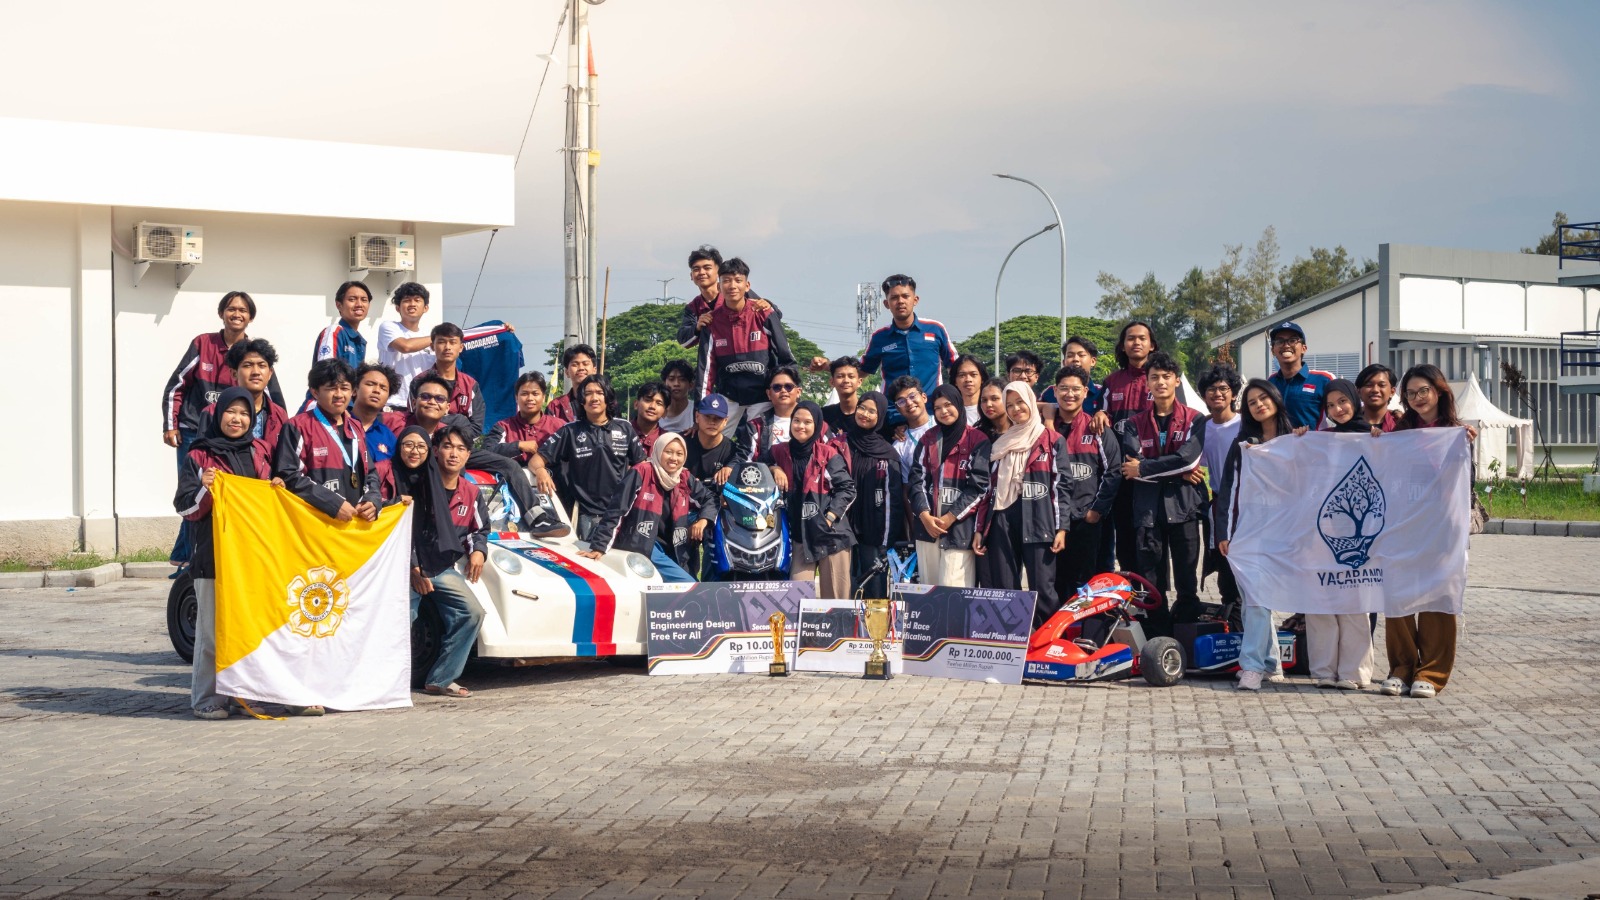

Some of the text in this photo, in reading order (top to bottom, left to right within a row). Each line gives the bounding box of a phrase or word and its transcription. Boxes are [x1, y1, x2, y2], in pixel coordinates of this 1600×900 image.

[1317, 568, 1384, 586] YACARAND
[650, 610, 672, 620] Drag
[650, 620, 736, 631] Engineering Design
[913, 622, 930, 630] Race
[689, 631, 701, 639] All
[971, 631, 1028, 642] Second Place Winner
[730, 642, 742, 652] Rp
[949, 647, 960, 658] Rp
